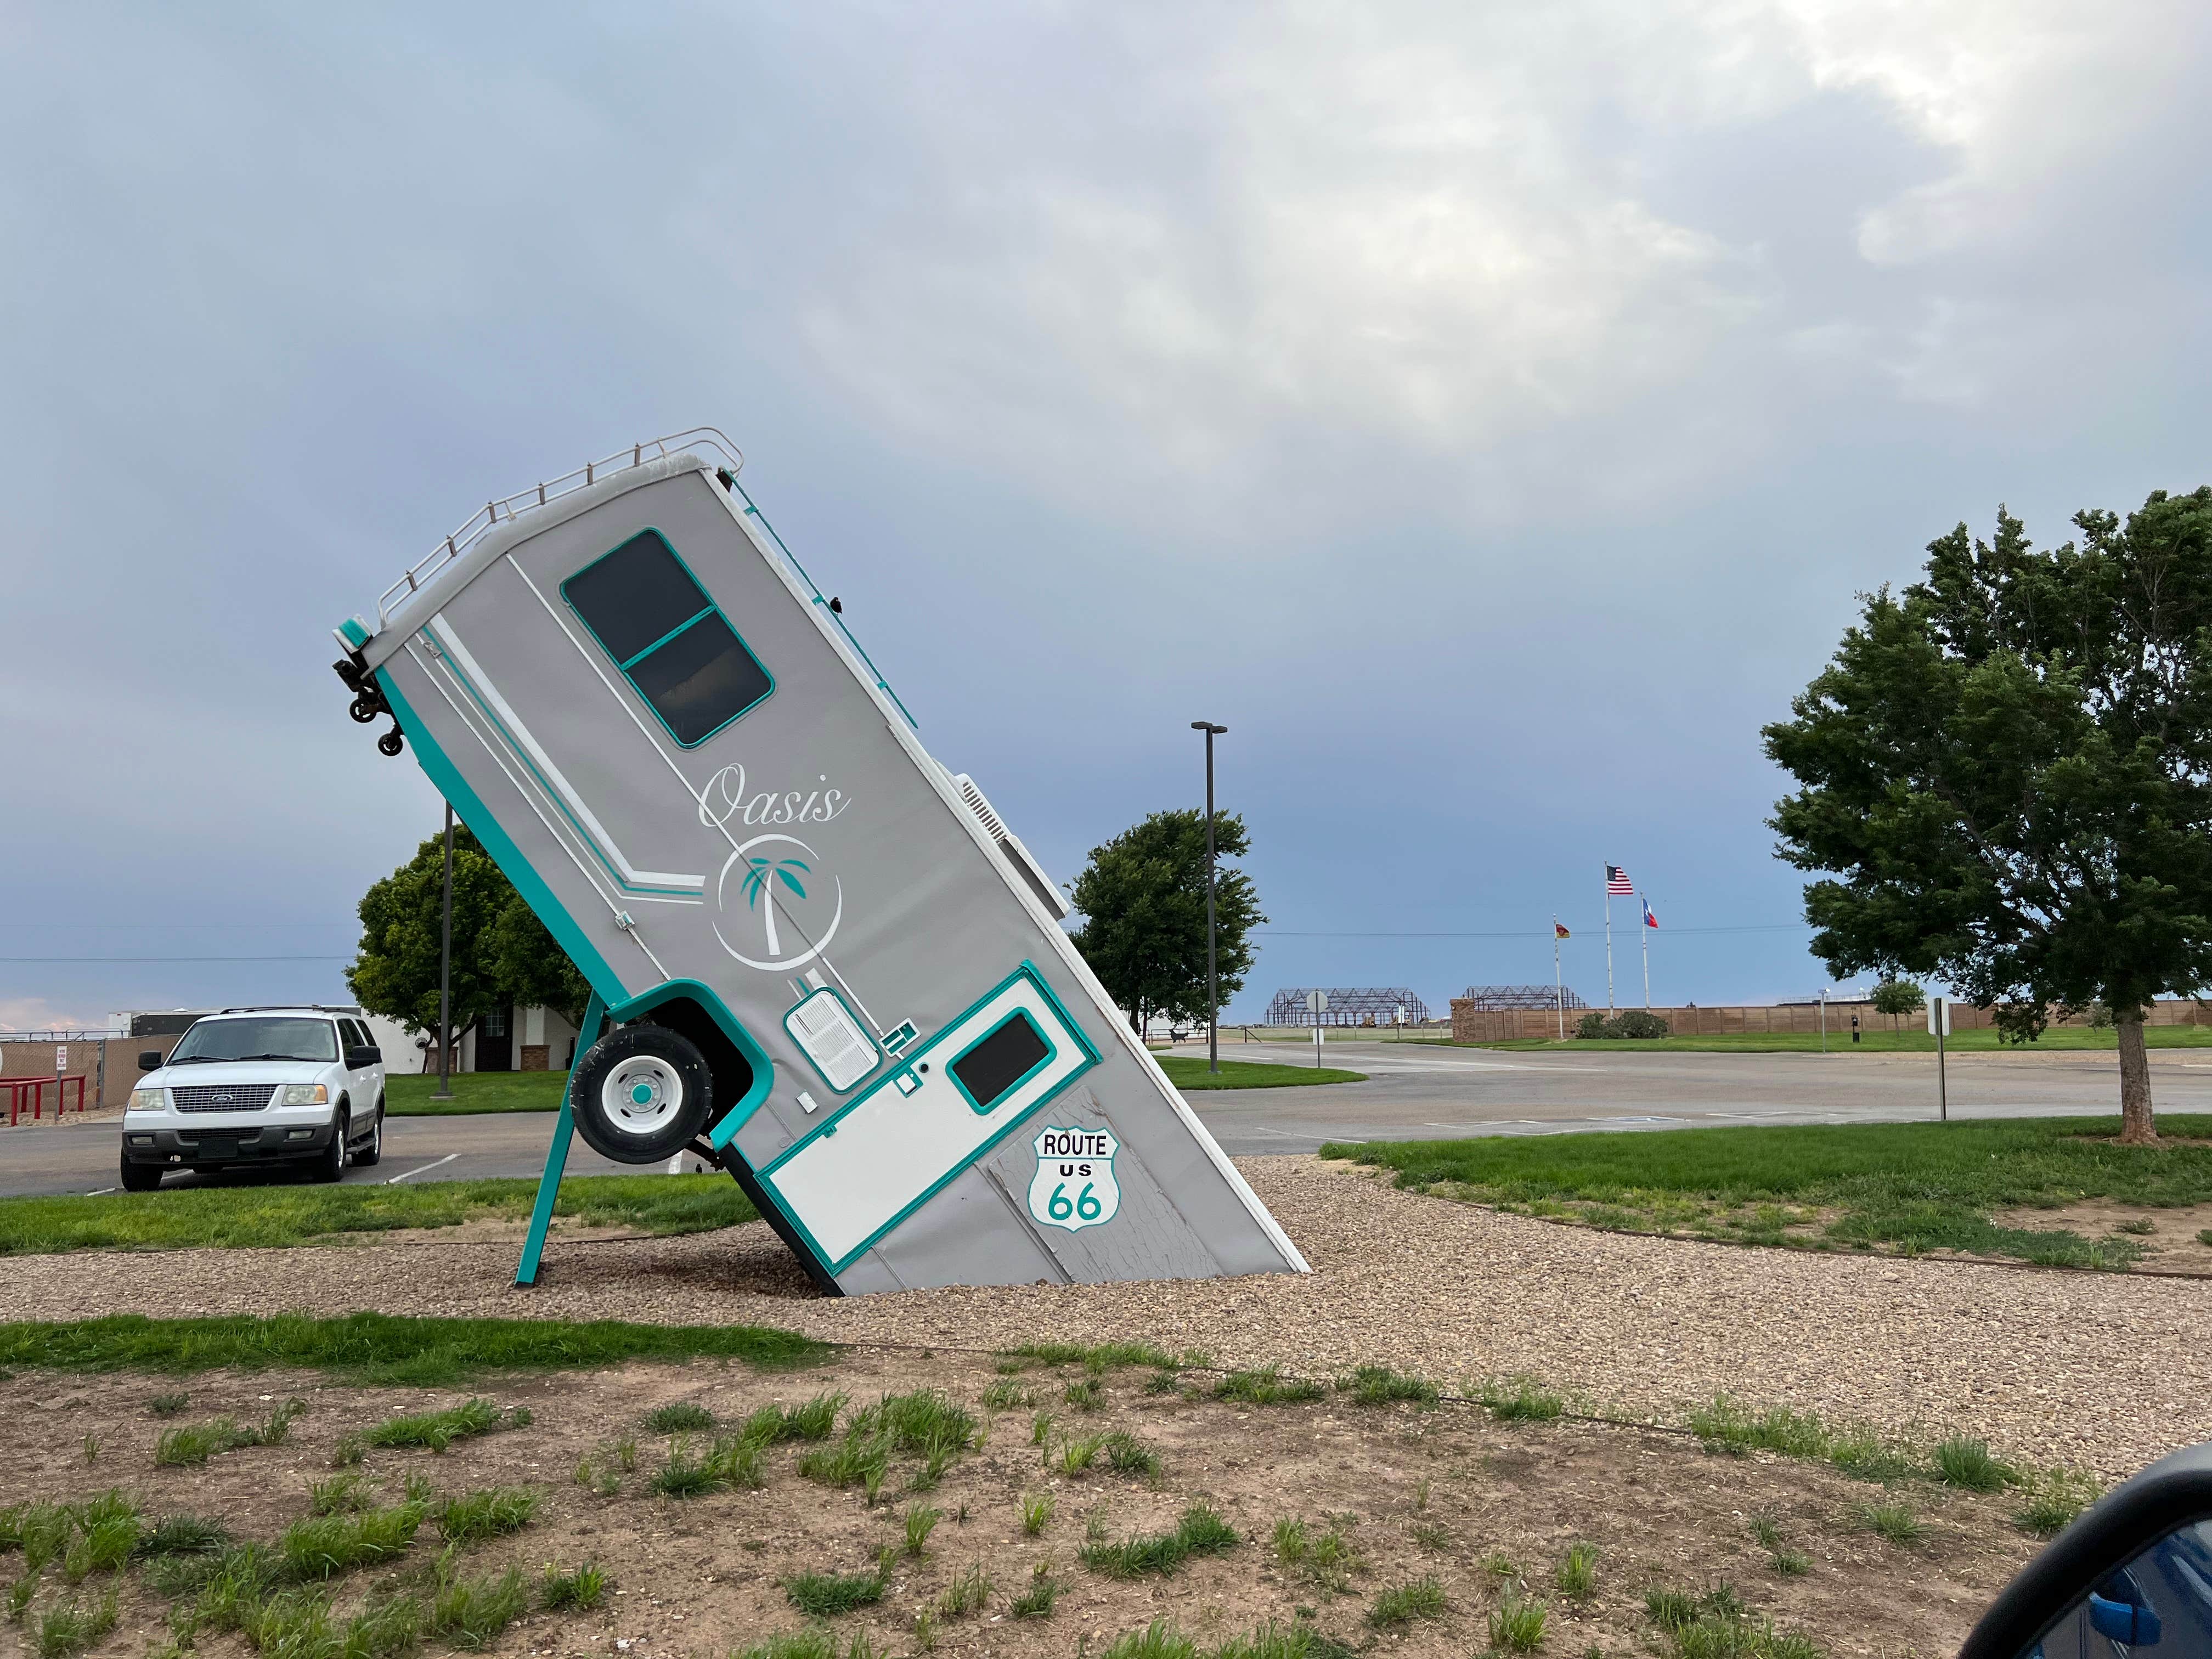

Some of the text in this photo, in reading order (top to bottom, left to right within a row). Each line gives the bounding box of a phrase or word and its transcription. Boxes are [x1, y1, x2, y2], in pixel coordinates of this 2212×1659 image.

[698, 763, 851, 827] Oasis
[1044, 1134, 1107, 1155] ROUTE
[1059, 1164, 1092, 1177] US
[1048, 1182, 1102, 1221] 66
